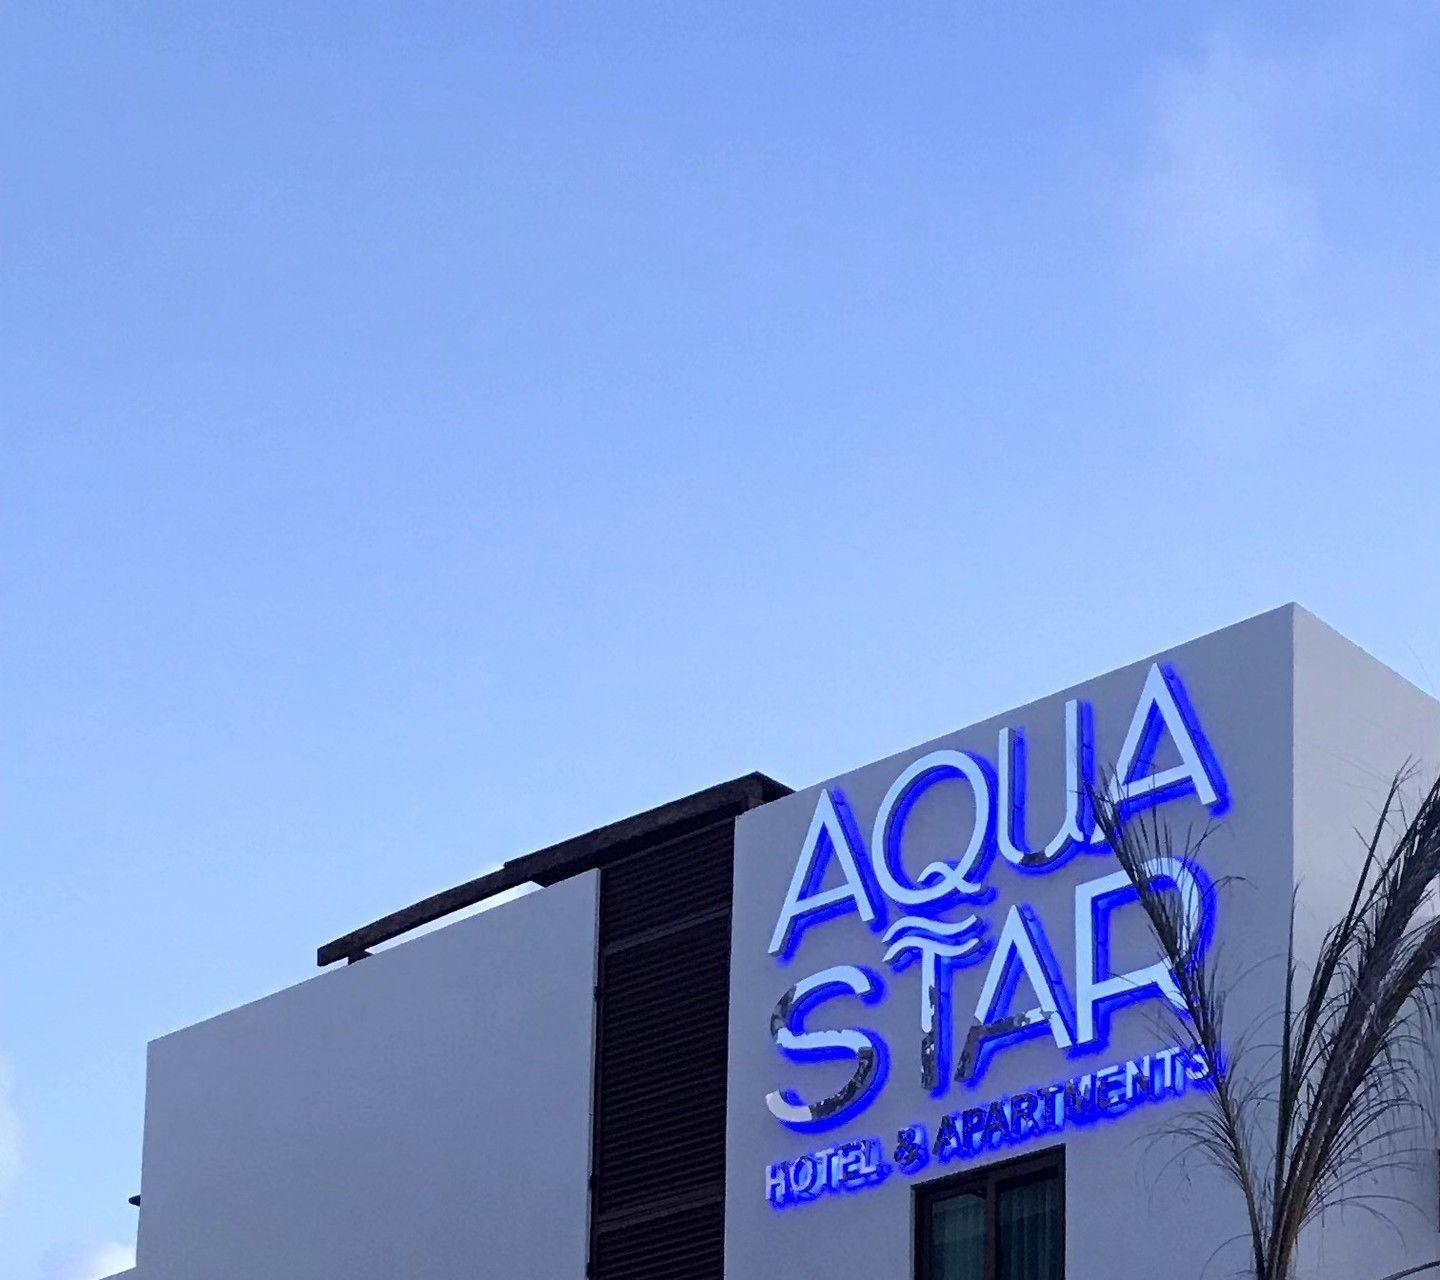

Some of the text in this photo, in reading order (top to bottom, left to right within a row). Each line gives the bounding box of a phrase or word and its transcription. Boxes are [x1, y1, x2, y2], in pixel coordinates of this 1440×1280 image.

[768, 662, 1224, 956] AQUA
[765, 857, 1212, 1124] STAR
[765, 1046, 1212, 1206] HOTEL & APARTMENTS
